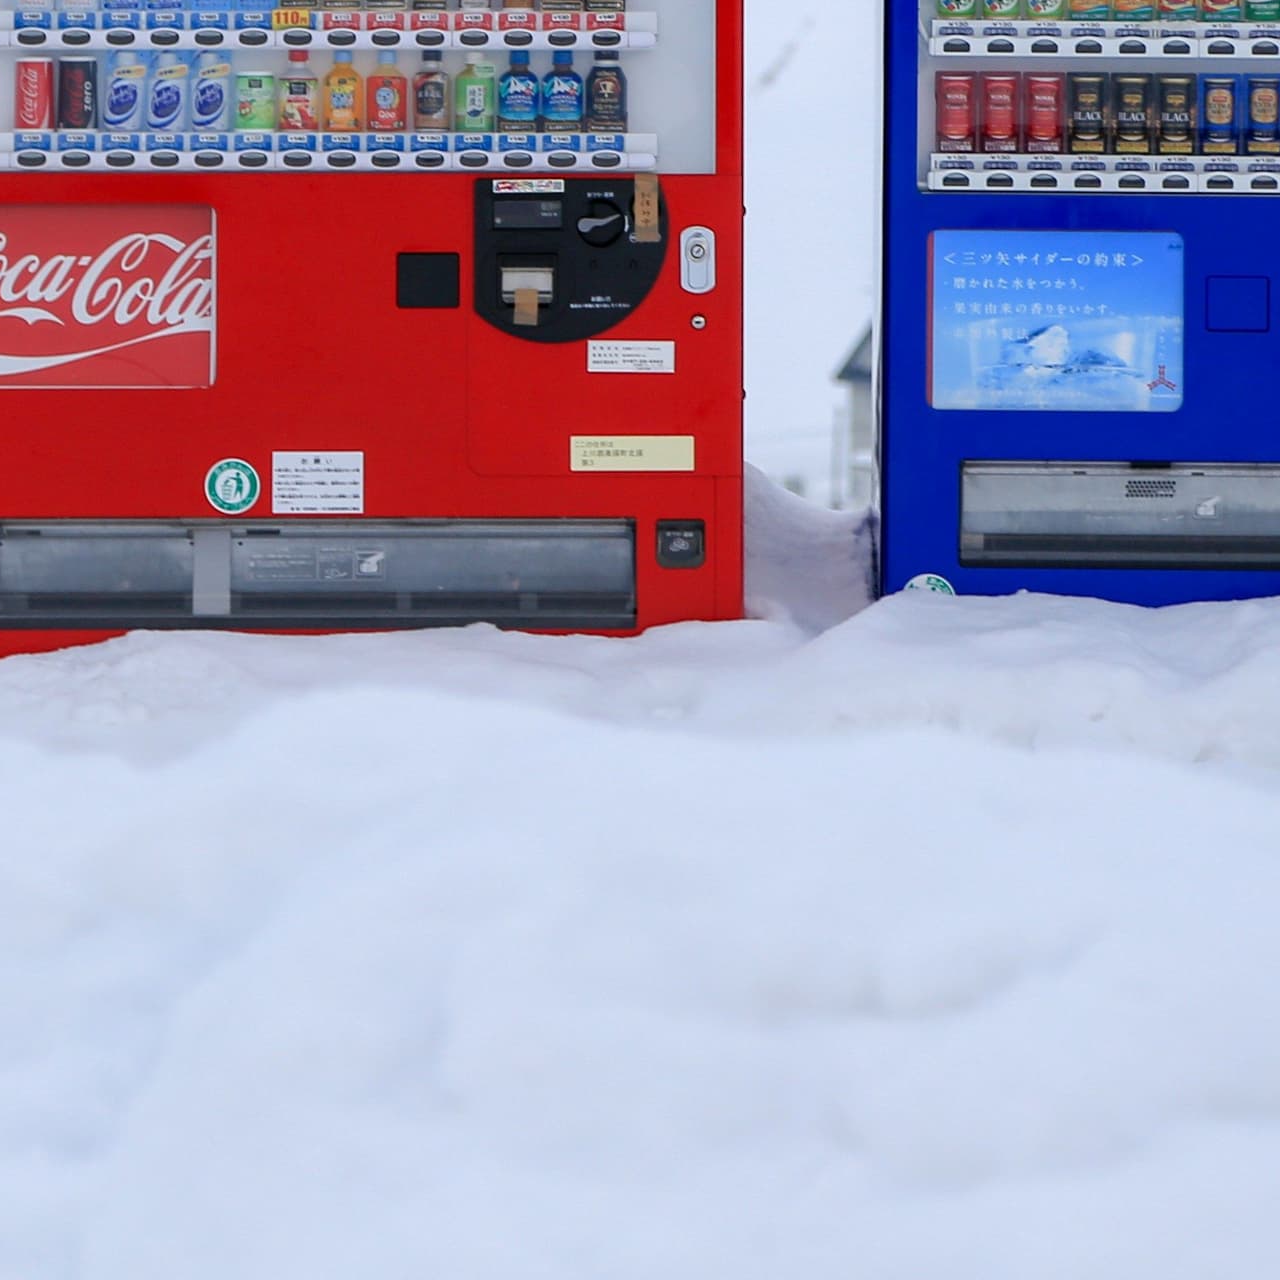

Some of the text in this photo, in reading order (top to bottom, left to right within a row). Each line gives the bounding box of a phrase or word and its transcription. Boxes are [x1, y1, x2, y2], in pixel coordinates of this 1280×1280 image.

[274, 11, 308, 24] 110円
[21, 68, 38, 124] Coca-Cola
[84, 81, 92, 112] zero
[378, 110, 395, 119] Qoo
[1073, 112, 1102, 121] BLACK
[1118, 112, 1146, 121] BLACK
[1162, 113, 1189, 122] BLACK
